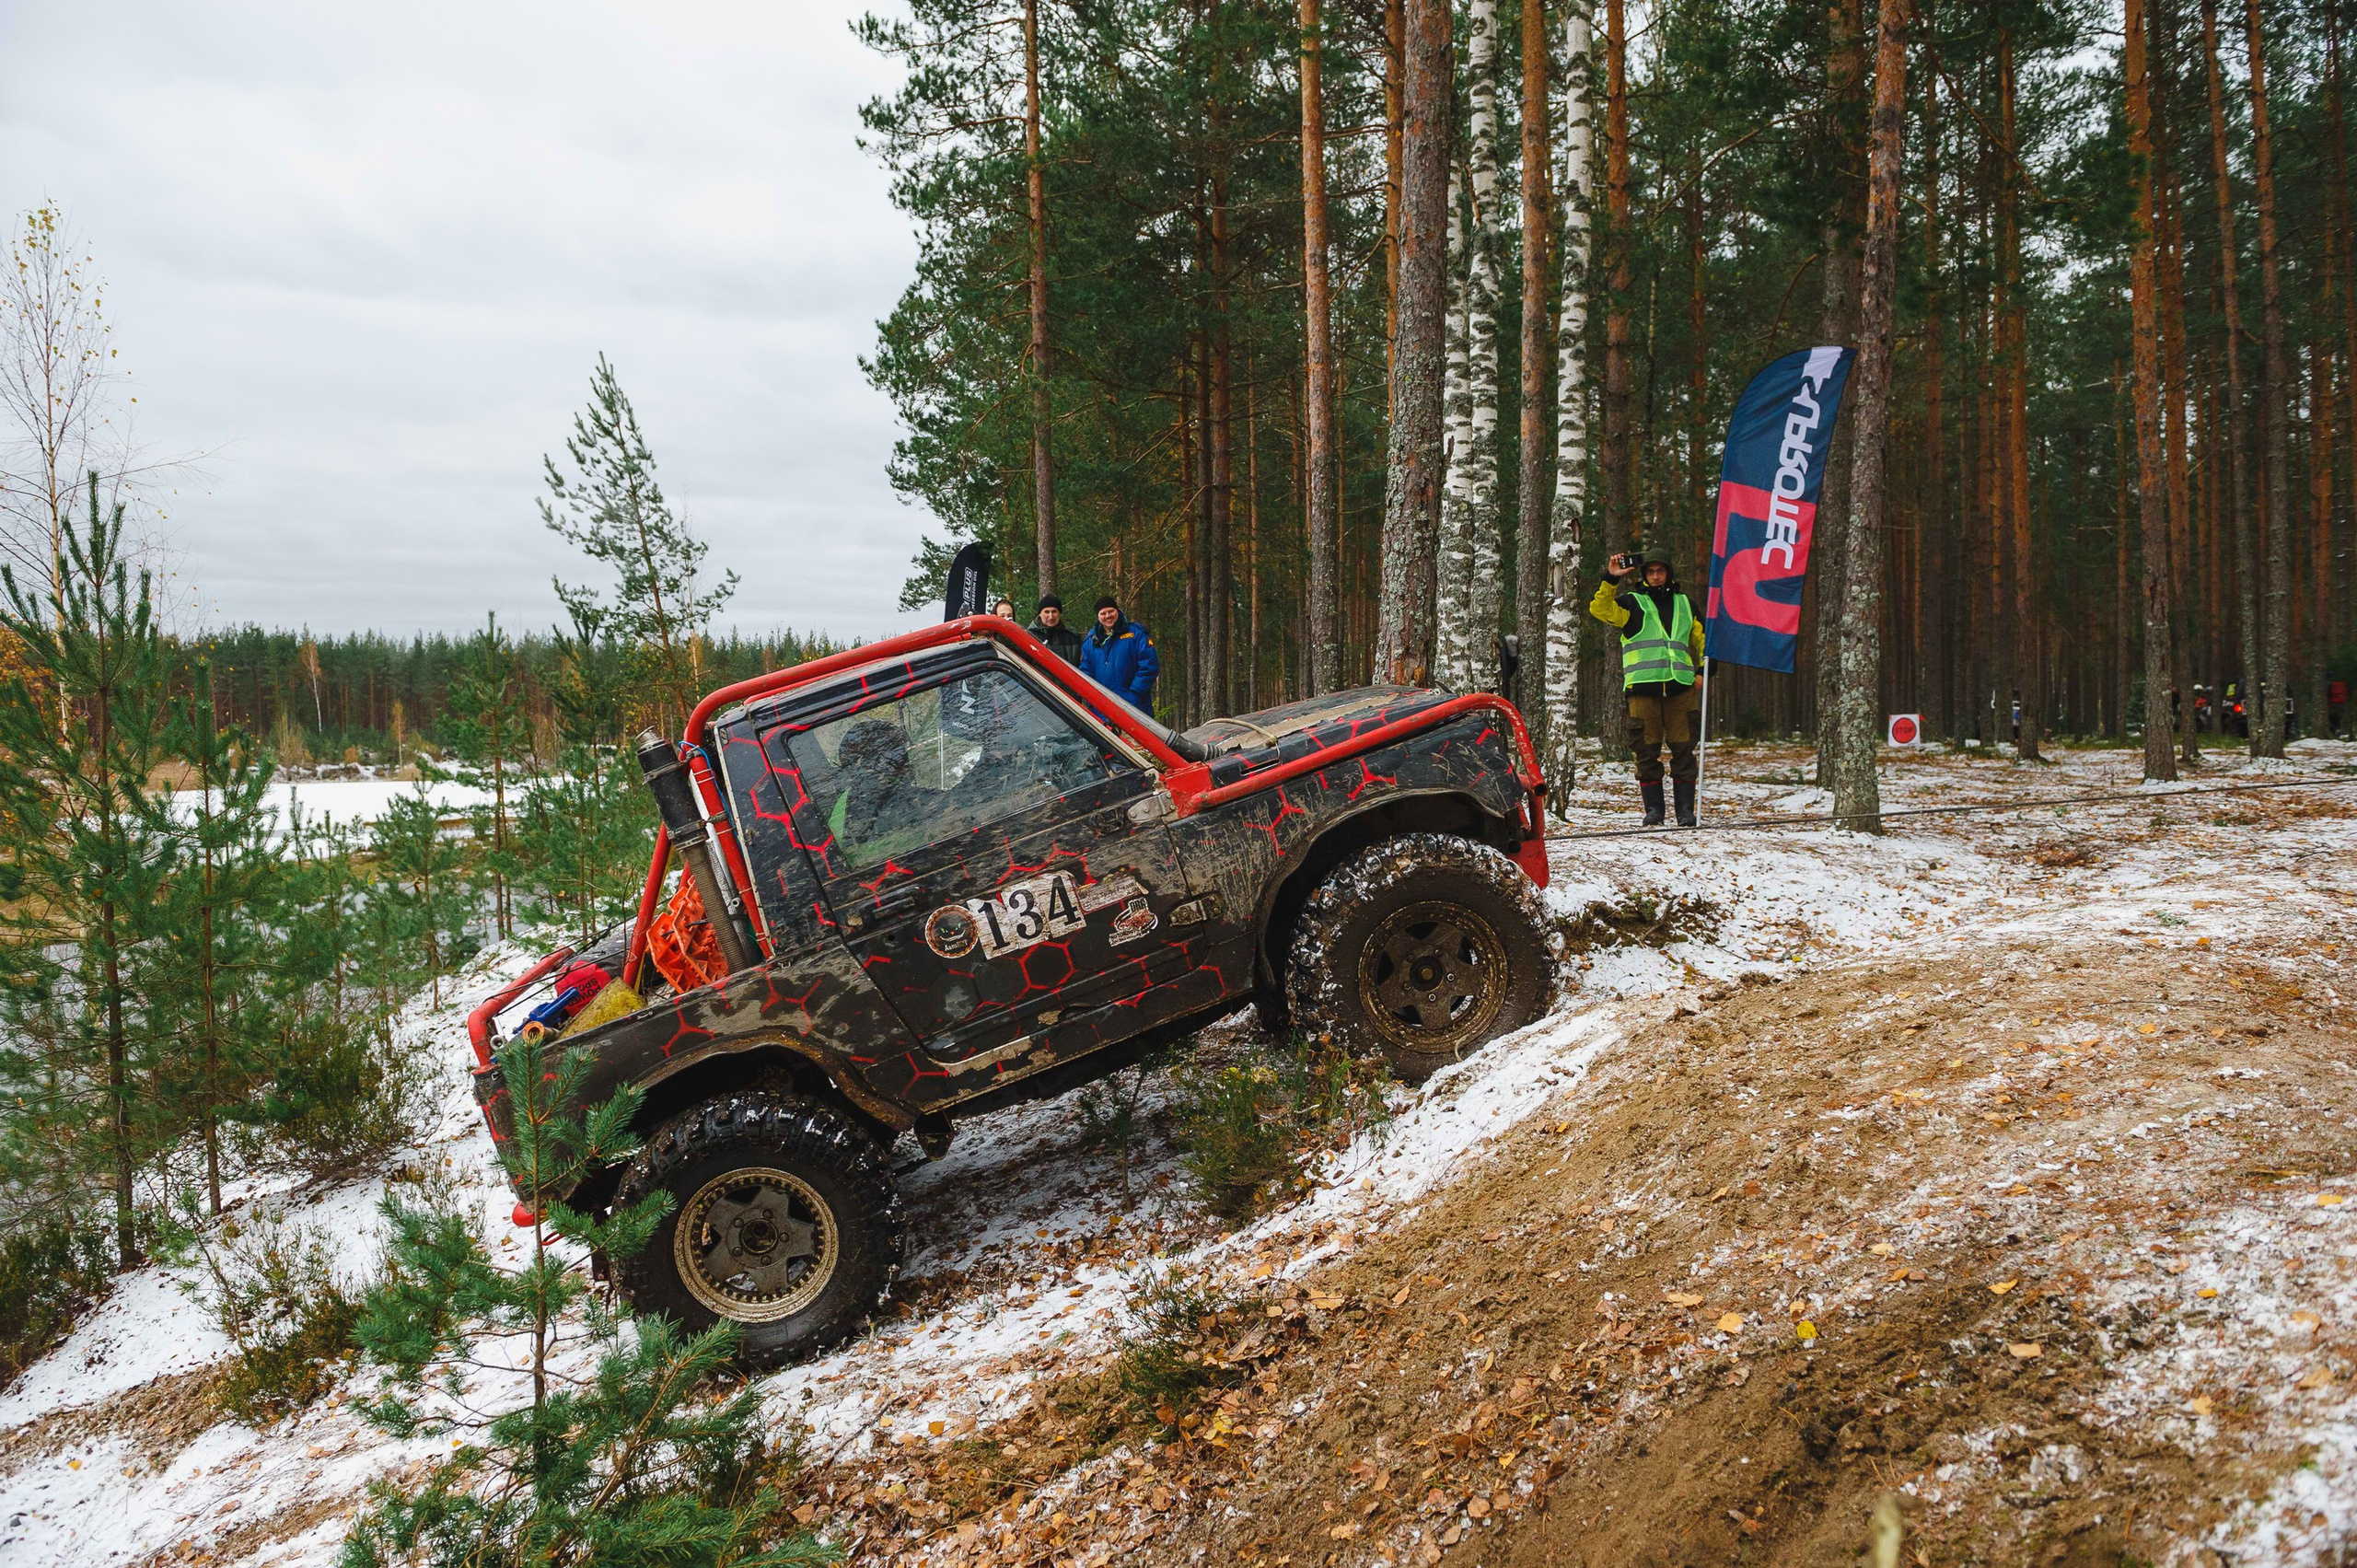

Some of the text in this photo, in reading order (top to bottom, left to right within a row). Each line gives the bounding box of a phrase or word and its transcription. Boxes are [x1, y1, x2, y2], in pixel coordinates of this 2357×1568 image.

[964, 570, 972, 600] PLUS
[978, 876, 1082, 951] 134
[577, 977, 598, 992] SPO
